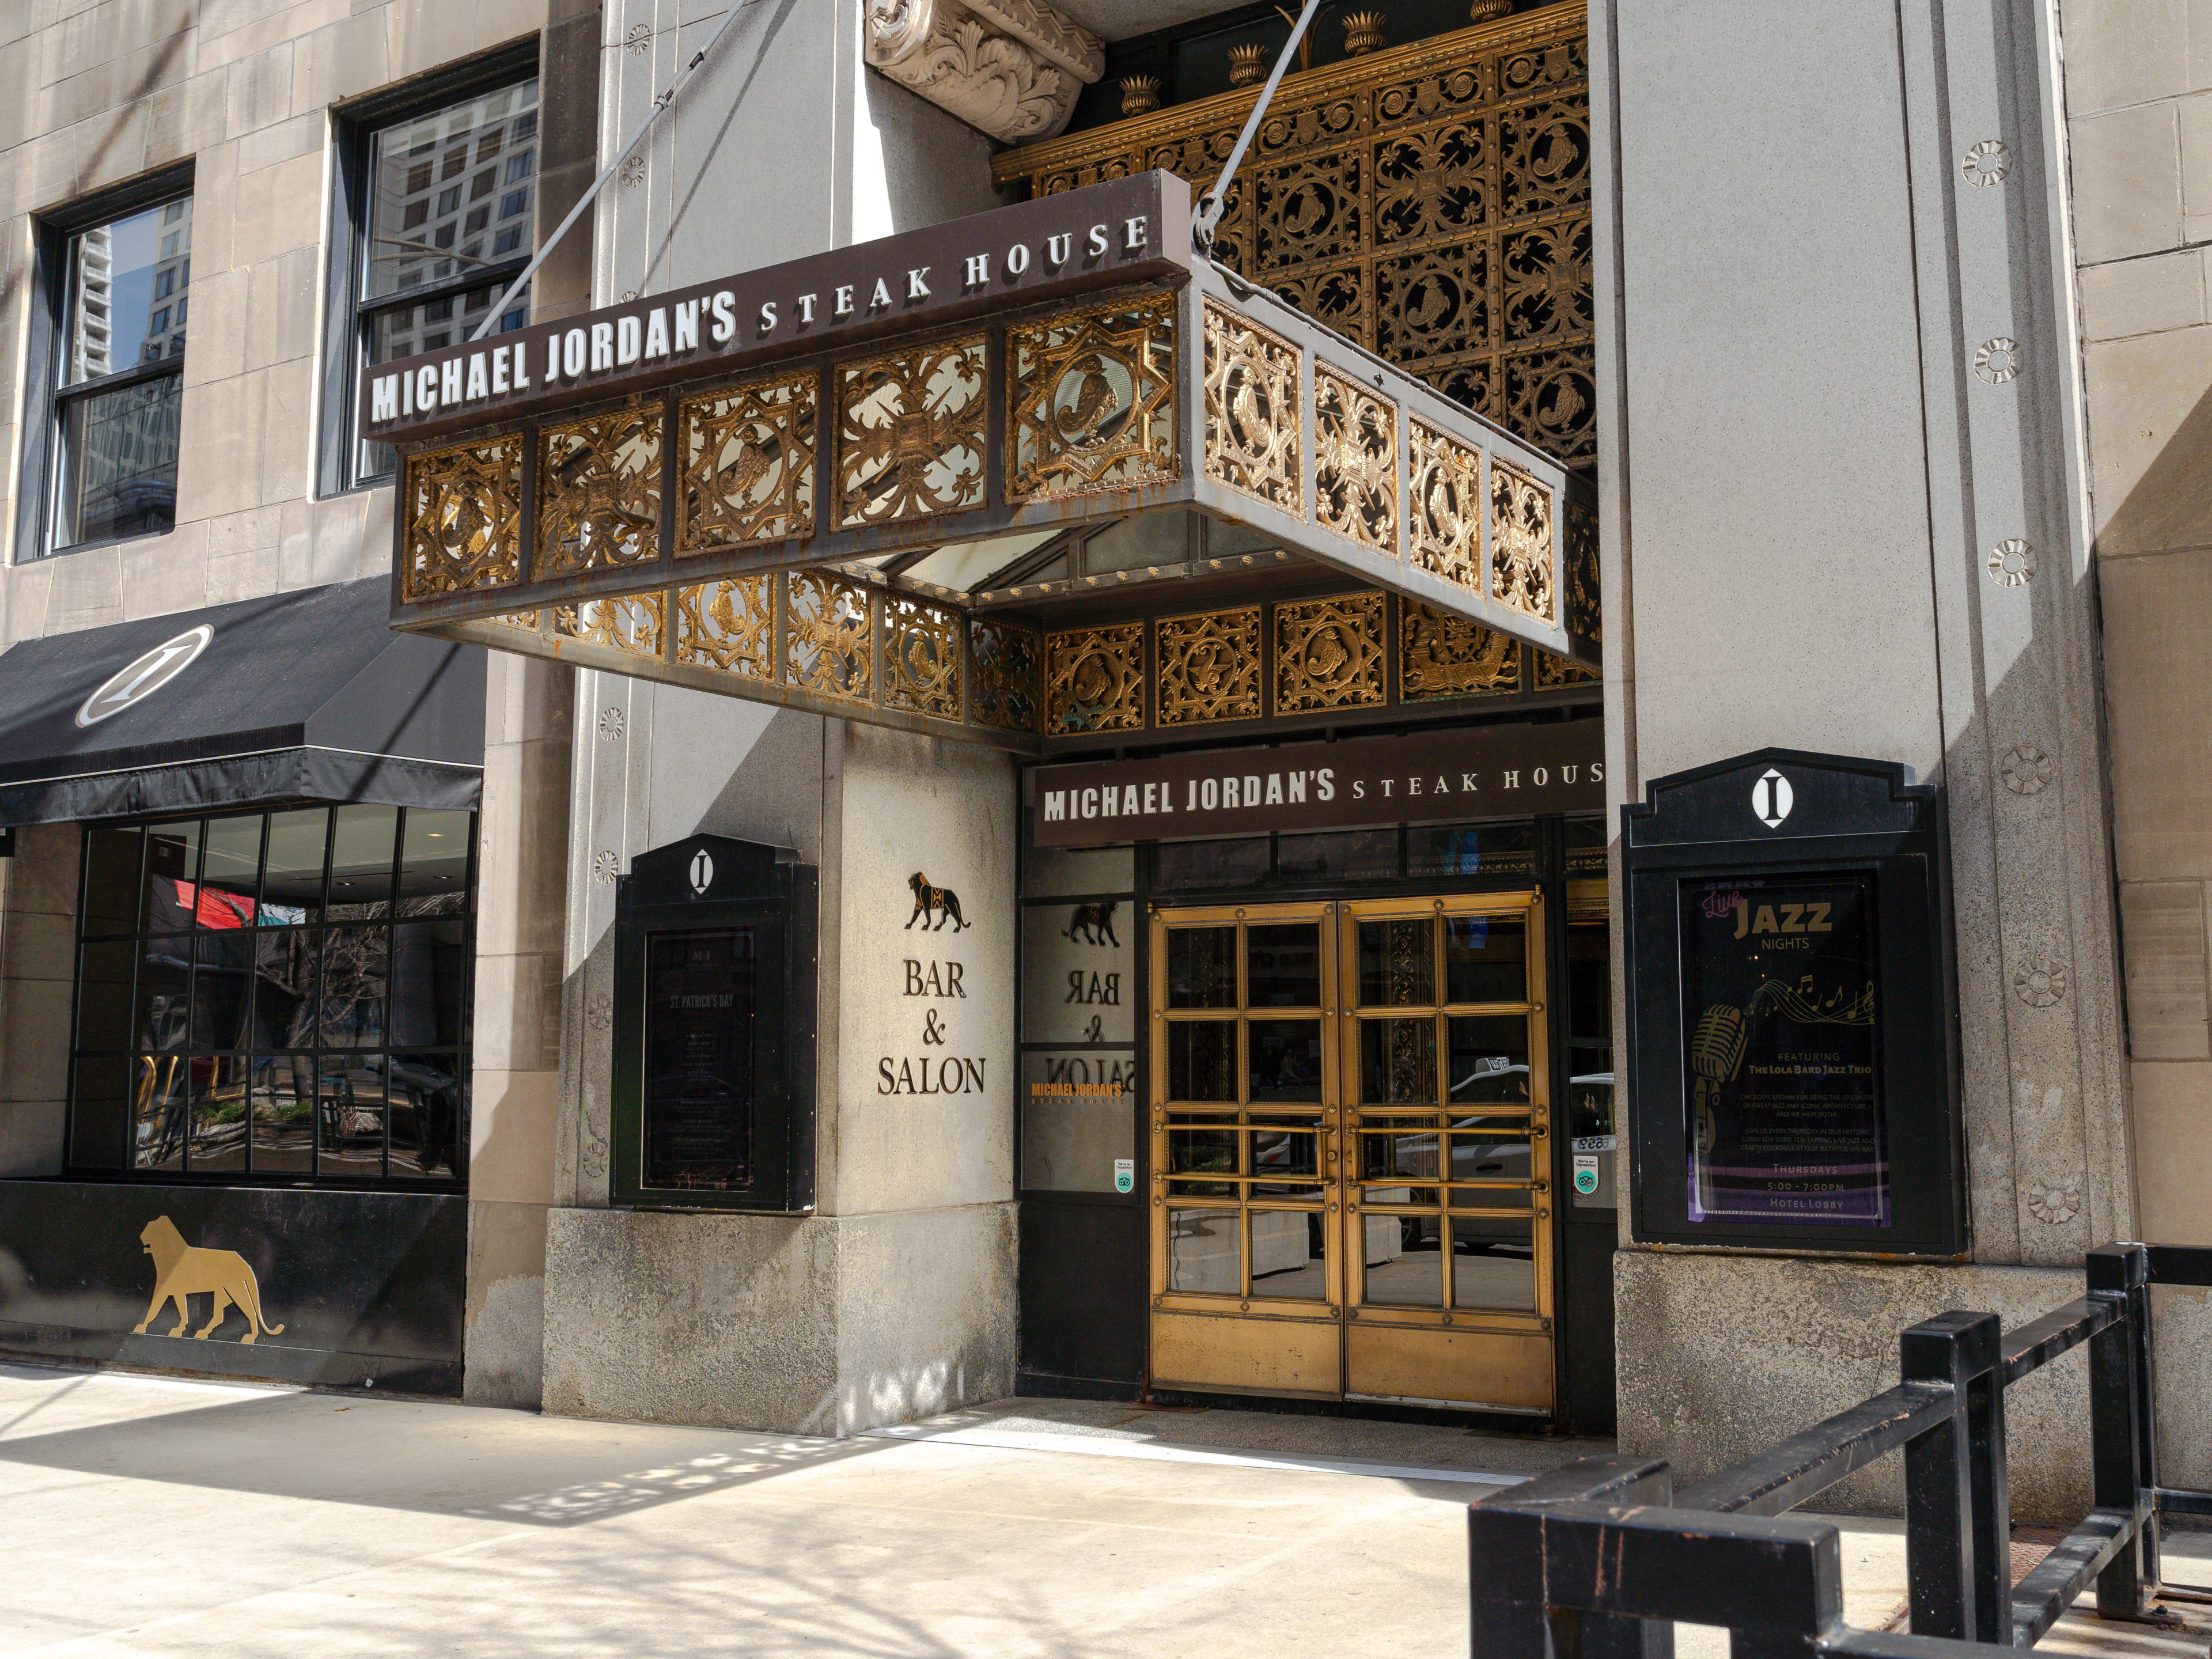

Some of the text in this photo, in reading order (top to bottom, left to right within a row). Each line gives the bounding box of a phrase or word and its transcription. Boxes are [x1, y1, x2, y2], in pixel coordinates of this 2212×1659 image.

[372, 215, 1147, 422] MICHAEL JORDAN'S STEAK HOUSE
[1044, 782, 1173, 823] MICHAEL
[1185, 767, 1336, 812] JORDAN'S
[1353, 773, 1479, 800] STEAK
[1702, 891, 1741, 918] Live
[1733, 899, 1832, 940] JAZZ
[1762, 938, 1809, 950] NIGHTS
[903, 959, 967, 998] BAR
[670, 994, 733, 1009] ST. PATRICK'S DAY
[923, 1008, 946, 1046] &
[1778, 1053, 1840, 1061] FEATURING
[878, 1056, 987, 1095] SALON
[1032, 1083, 1123, 1097] MICHAEL JORDAN'S
[1767, 1182, 1791, 1191] 5:00
[1803, 1183, 1844, 1192] 7:00PM
